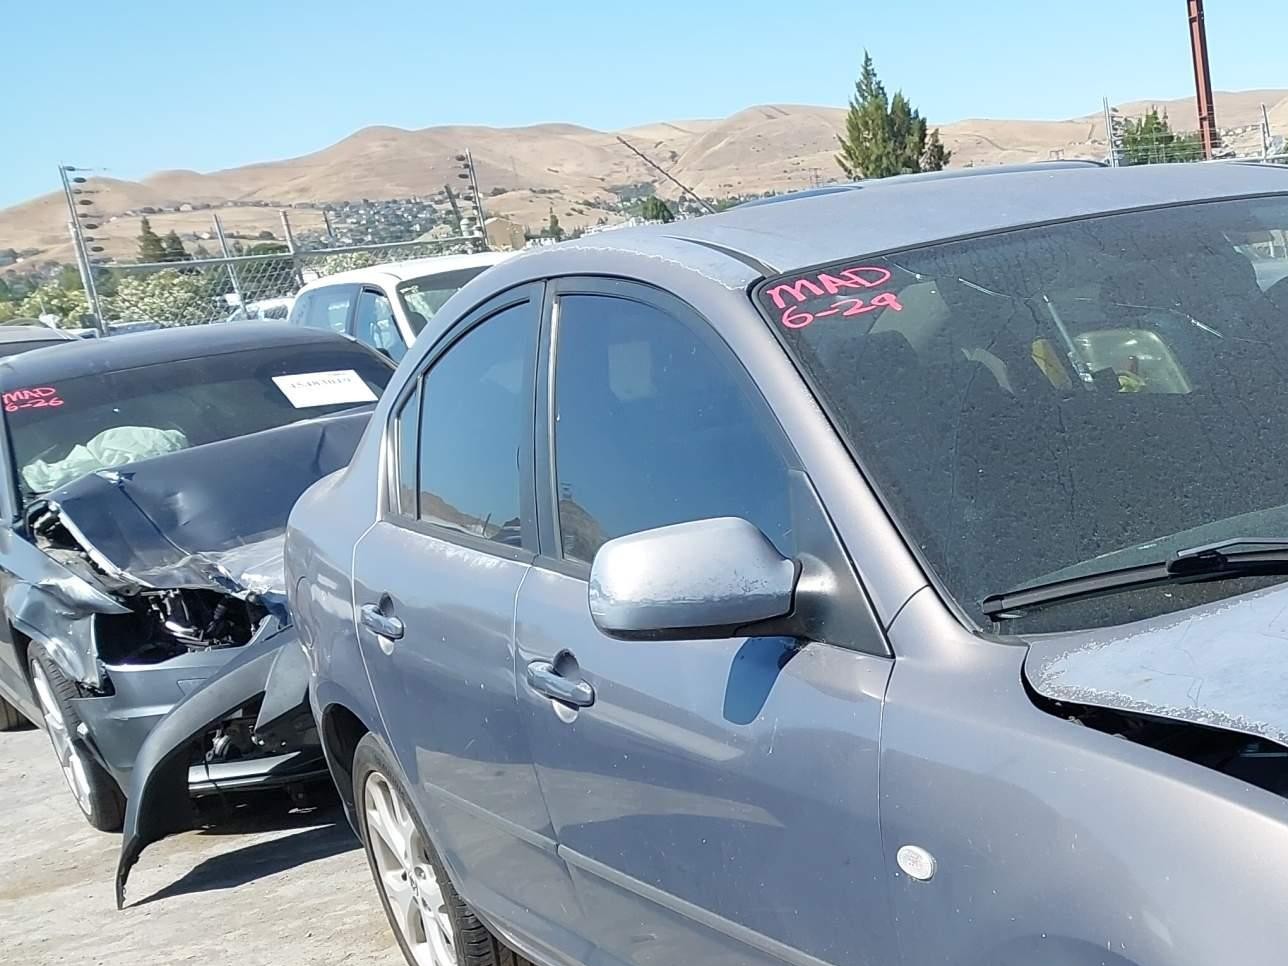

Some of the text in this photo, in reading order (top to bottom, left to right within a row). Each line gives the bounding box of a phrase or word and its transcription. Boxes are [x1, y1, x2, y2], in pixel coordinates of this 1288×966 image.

[766, 266, 892, 309] MAD
[781, 292, 903, 329] 6-29
[1, 387, 56, 405] MAD
[5, 396, 64, 412] 6-26
